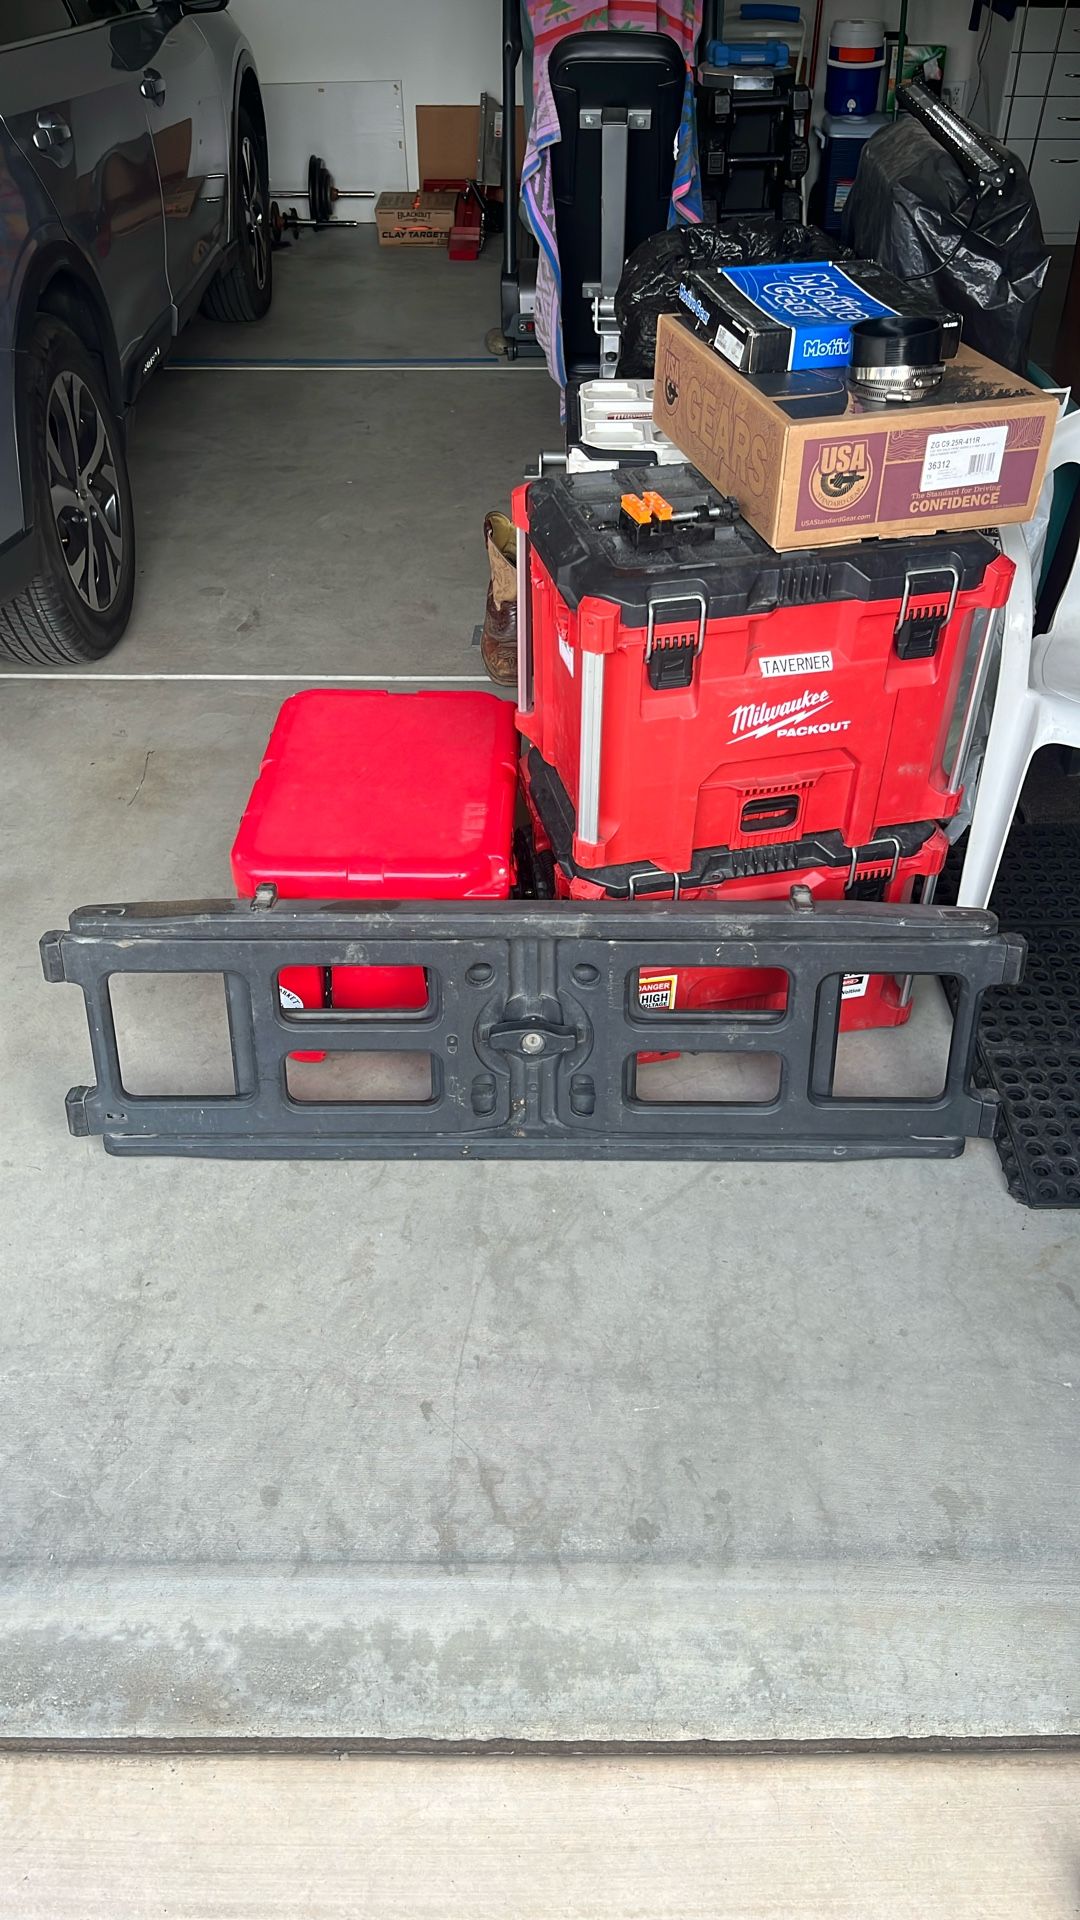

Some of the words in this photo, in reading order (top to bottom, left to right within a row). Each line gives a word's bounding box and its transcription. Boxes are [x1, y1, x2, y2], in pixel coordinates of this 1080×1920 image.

[382, 231, 407, 239] CLAY
[763, 283, 828, 317] Gear
[789, 274, 869, 320] Motive
[803, 338, 850, 358] Motiv
[930, 440, 941, 449] ZG
[820, 443, 865, 475] USA
[927, 459, 951, 471] 36312
[911, 492, 925, 500] The
[926, 488, 960, 499] Standard
[961, 486, 973, 494] for
[973, 484, 1002, 493] Driving
[909, 492, 1000, 513] CONFIDENCE
[800, 514, 871, 527] USAStandardGear.com
[763, 654, 830, 674] TAVERNER
[727, 689, 830, 735] Milwaukee
[776, 720, 851, 738] PACKOUT
[641, 992, 668, 1004] HIGH
